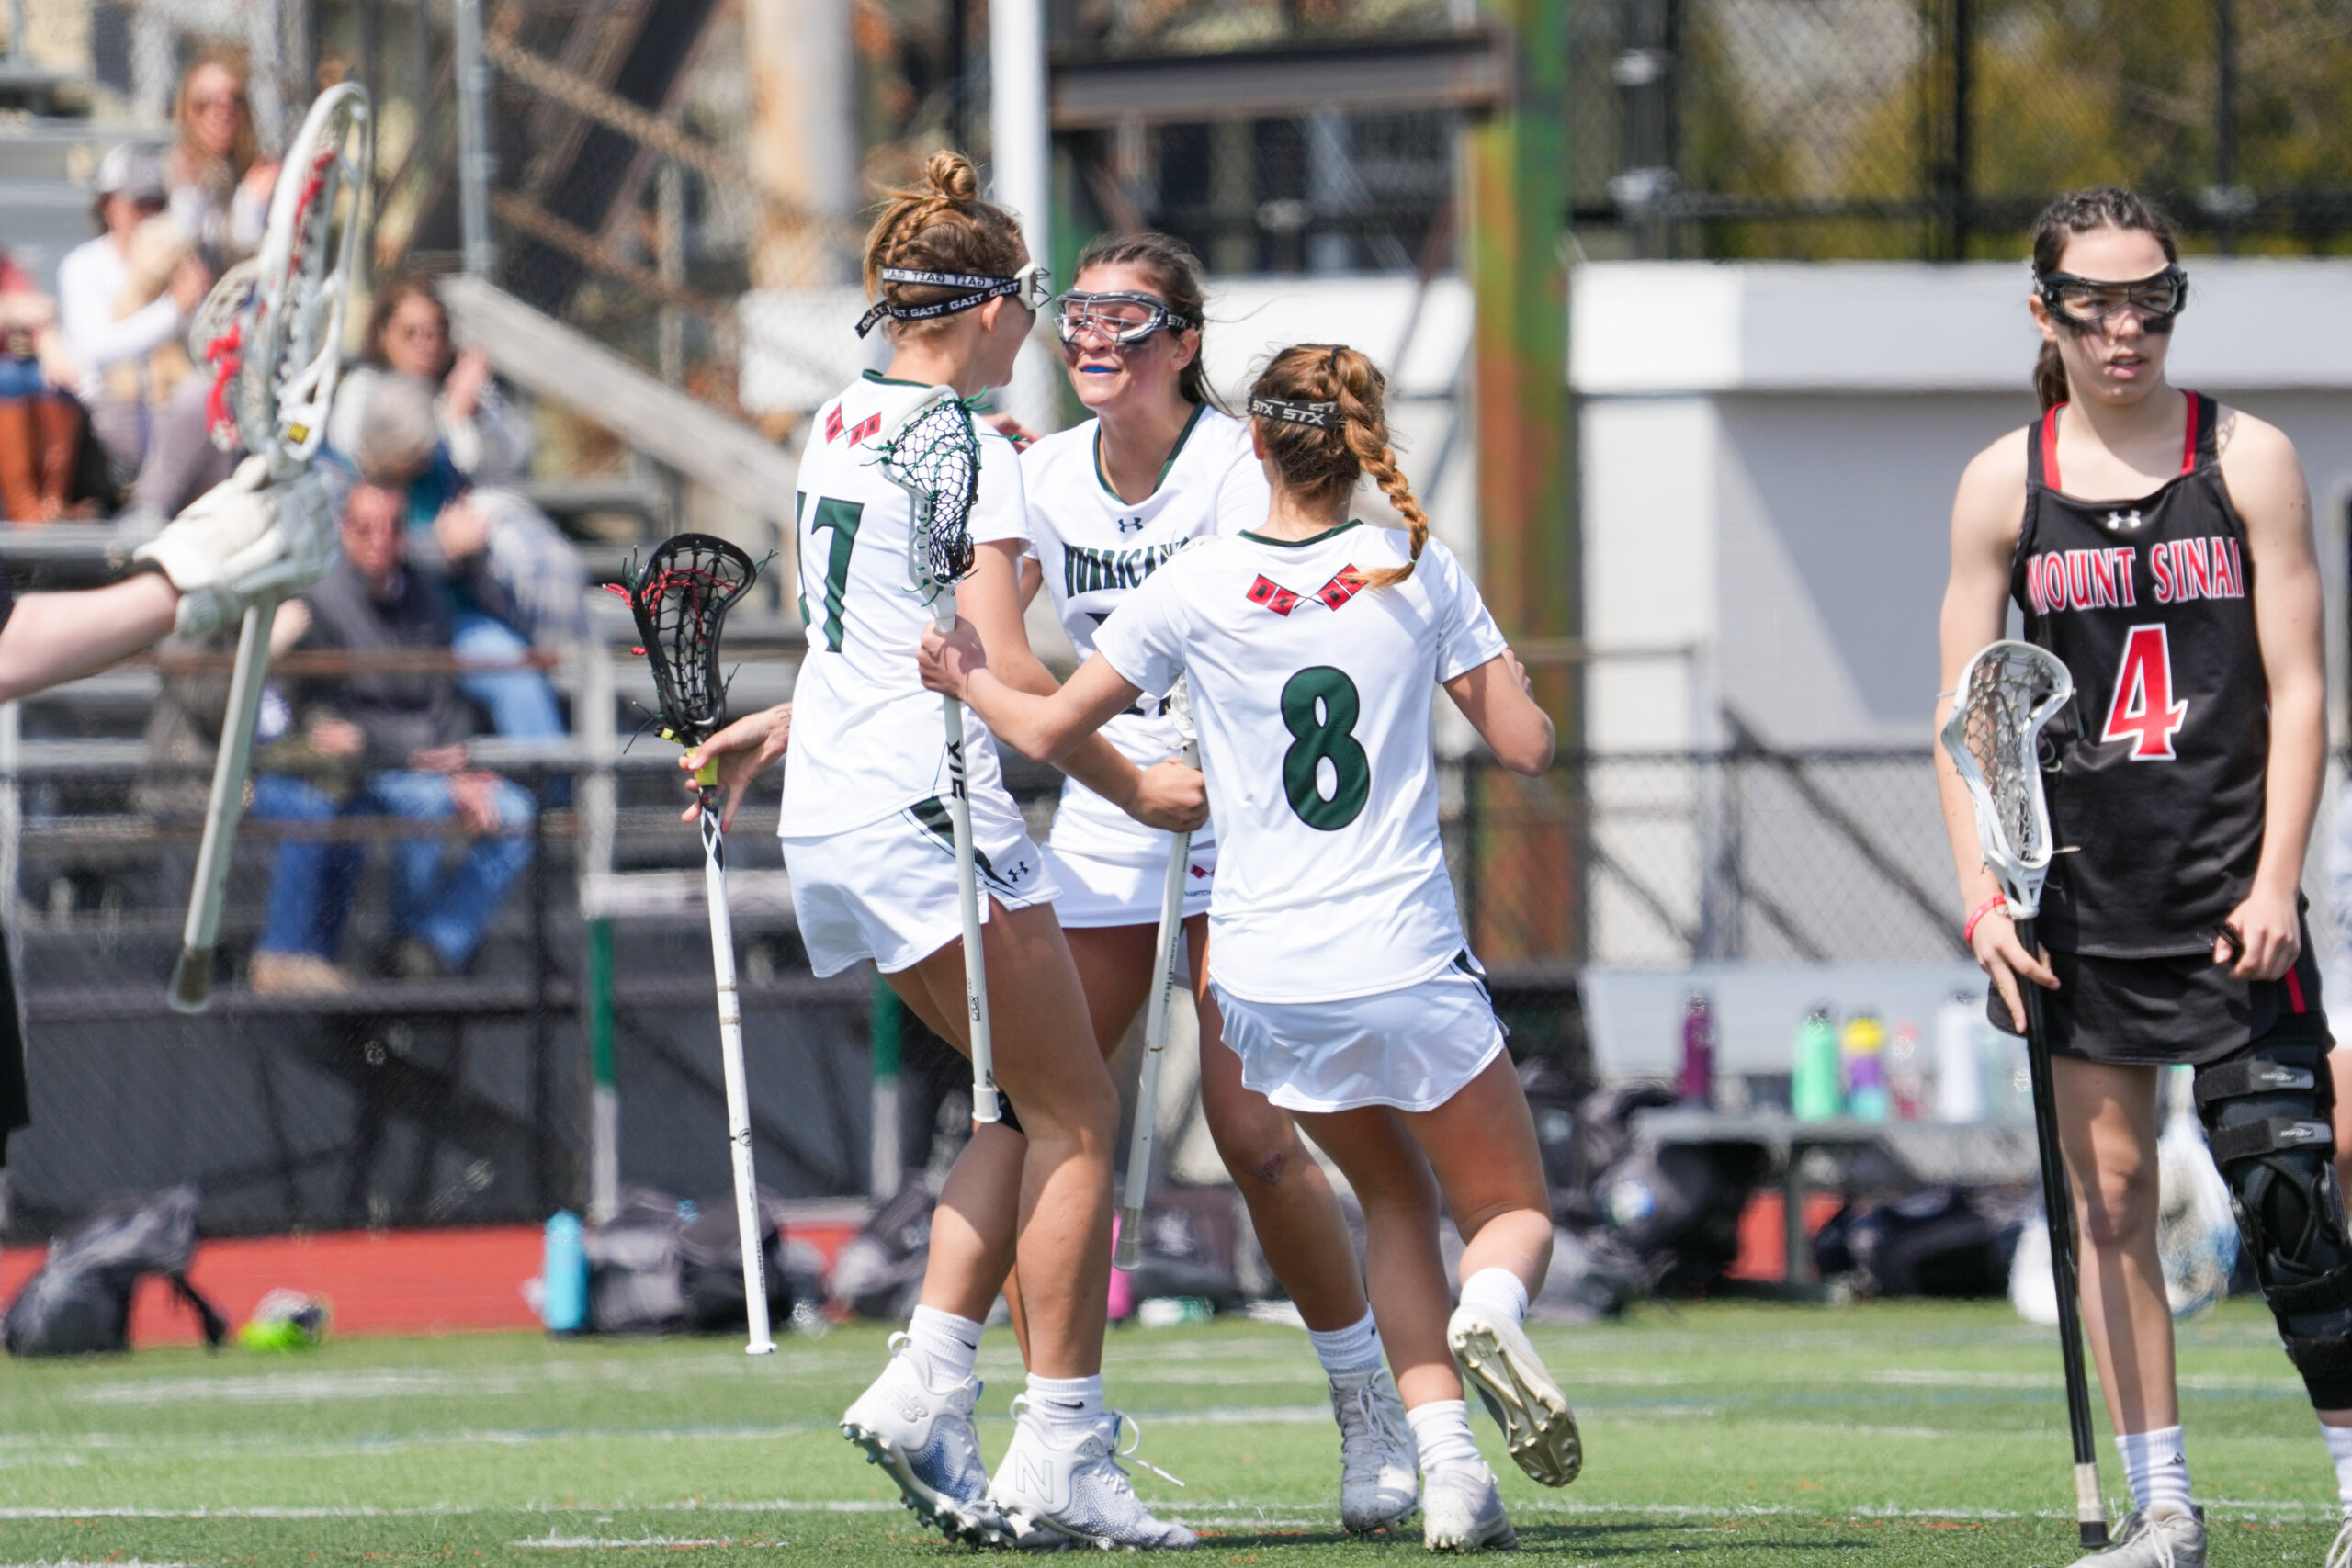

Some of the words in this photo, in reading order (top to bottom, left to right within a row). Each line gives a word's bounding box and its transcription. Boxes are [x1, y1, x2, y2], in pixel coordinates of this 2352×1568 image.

[910, 304, 944, 318] GAIT
[949, 293, 984, 310] GAIT
[989, 281, 1021, 298] GAIT
[1252, 400, 1273, 416] STX
[1282, 408, 1325, 425] STX
[2026, 547, 2137, 616] MOUNT
[2150, 536, 2245, 604] SINAI
[2100, 623, 2189, 761] 4
[1280, 665, 1371, 831] 8
